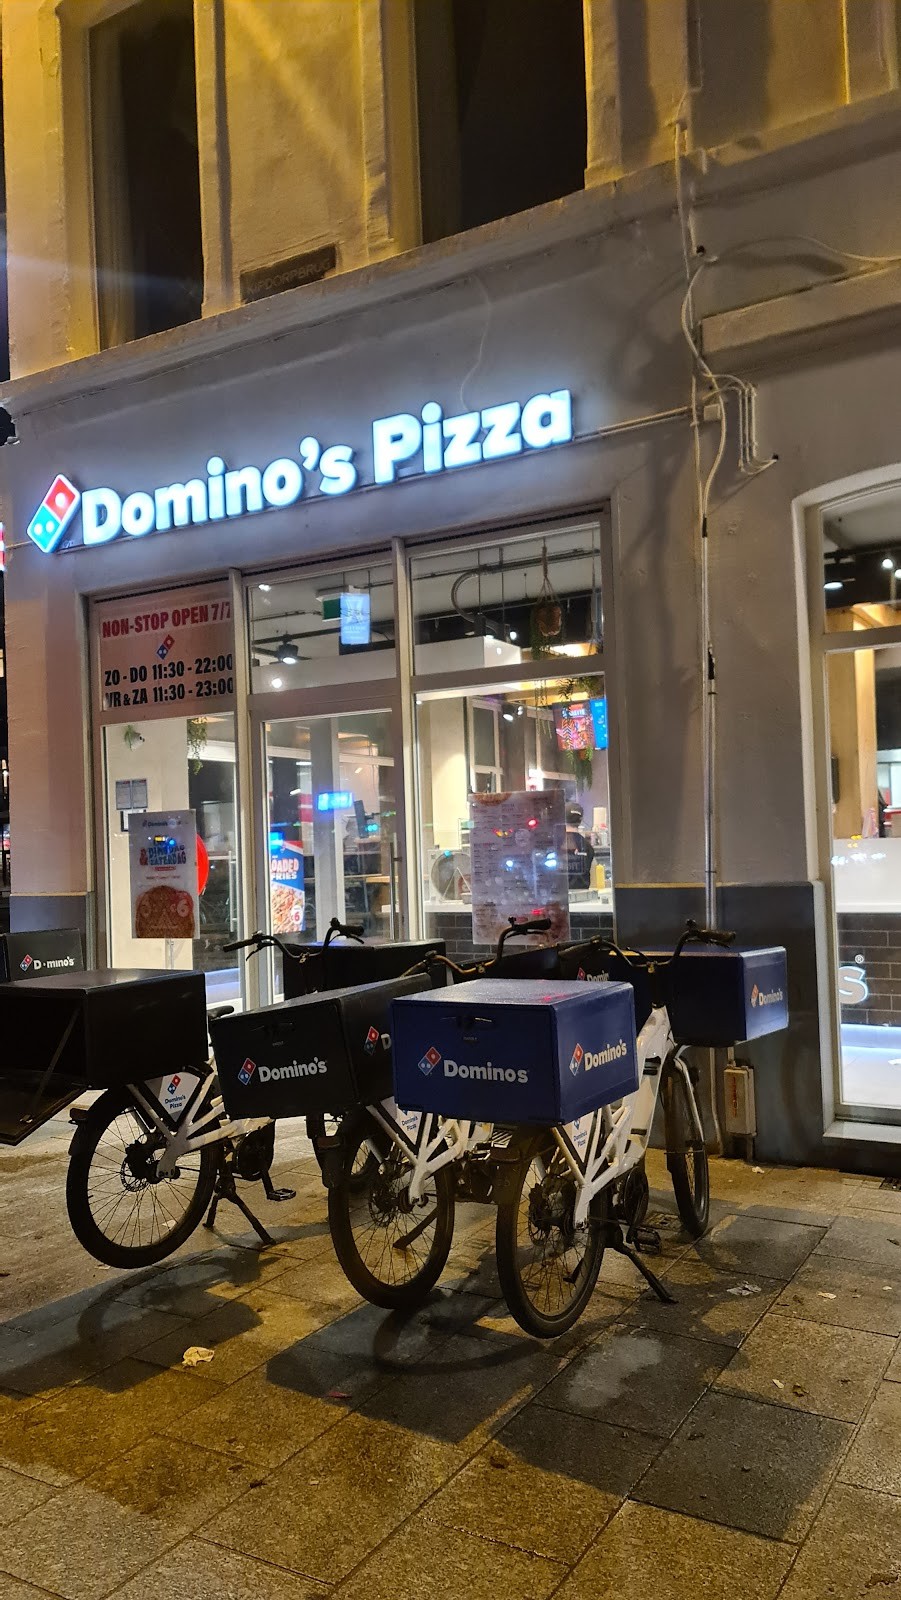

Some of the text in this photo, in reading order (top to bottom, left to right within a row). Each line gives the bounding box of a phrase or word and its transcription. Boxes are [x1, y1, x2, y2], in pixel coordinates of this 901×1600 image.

[81, 388, 573, 546] Domino's Pizza
[102, 601, 231, 638] NON-STOP OPEN 7/7
[104, 669, 121, 687] ZO
[129, 665, 148, 683] DO
[152, 660, 185, 680] 11:30
[194, 653, 233, 674] 22:00
[132, 688, 149, 705] ZA
[153, 683, 186, 702] 11:30
[195, 677, 234, 698] 23:00
[270, 858, 299, 873] OADED
[258, 1056, 328, 1083] Domino's
[584, 1039, 627, 1071] Domino's
